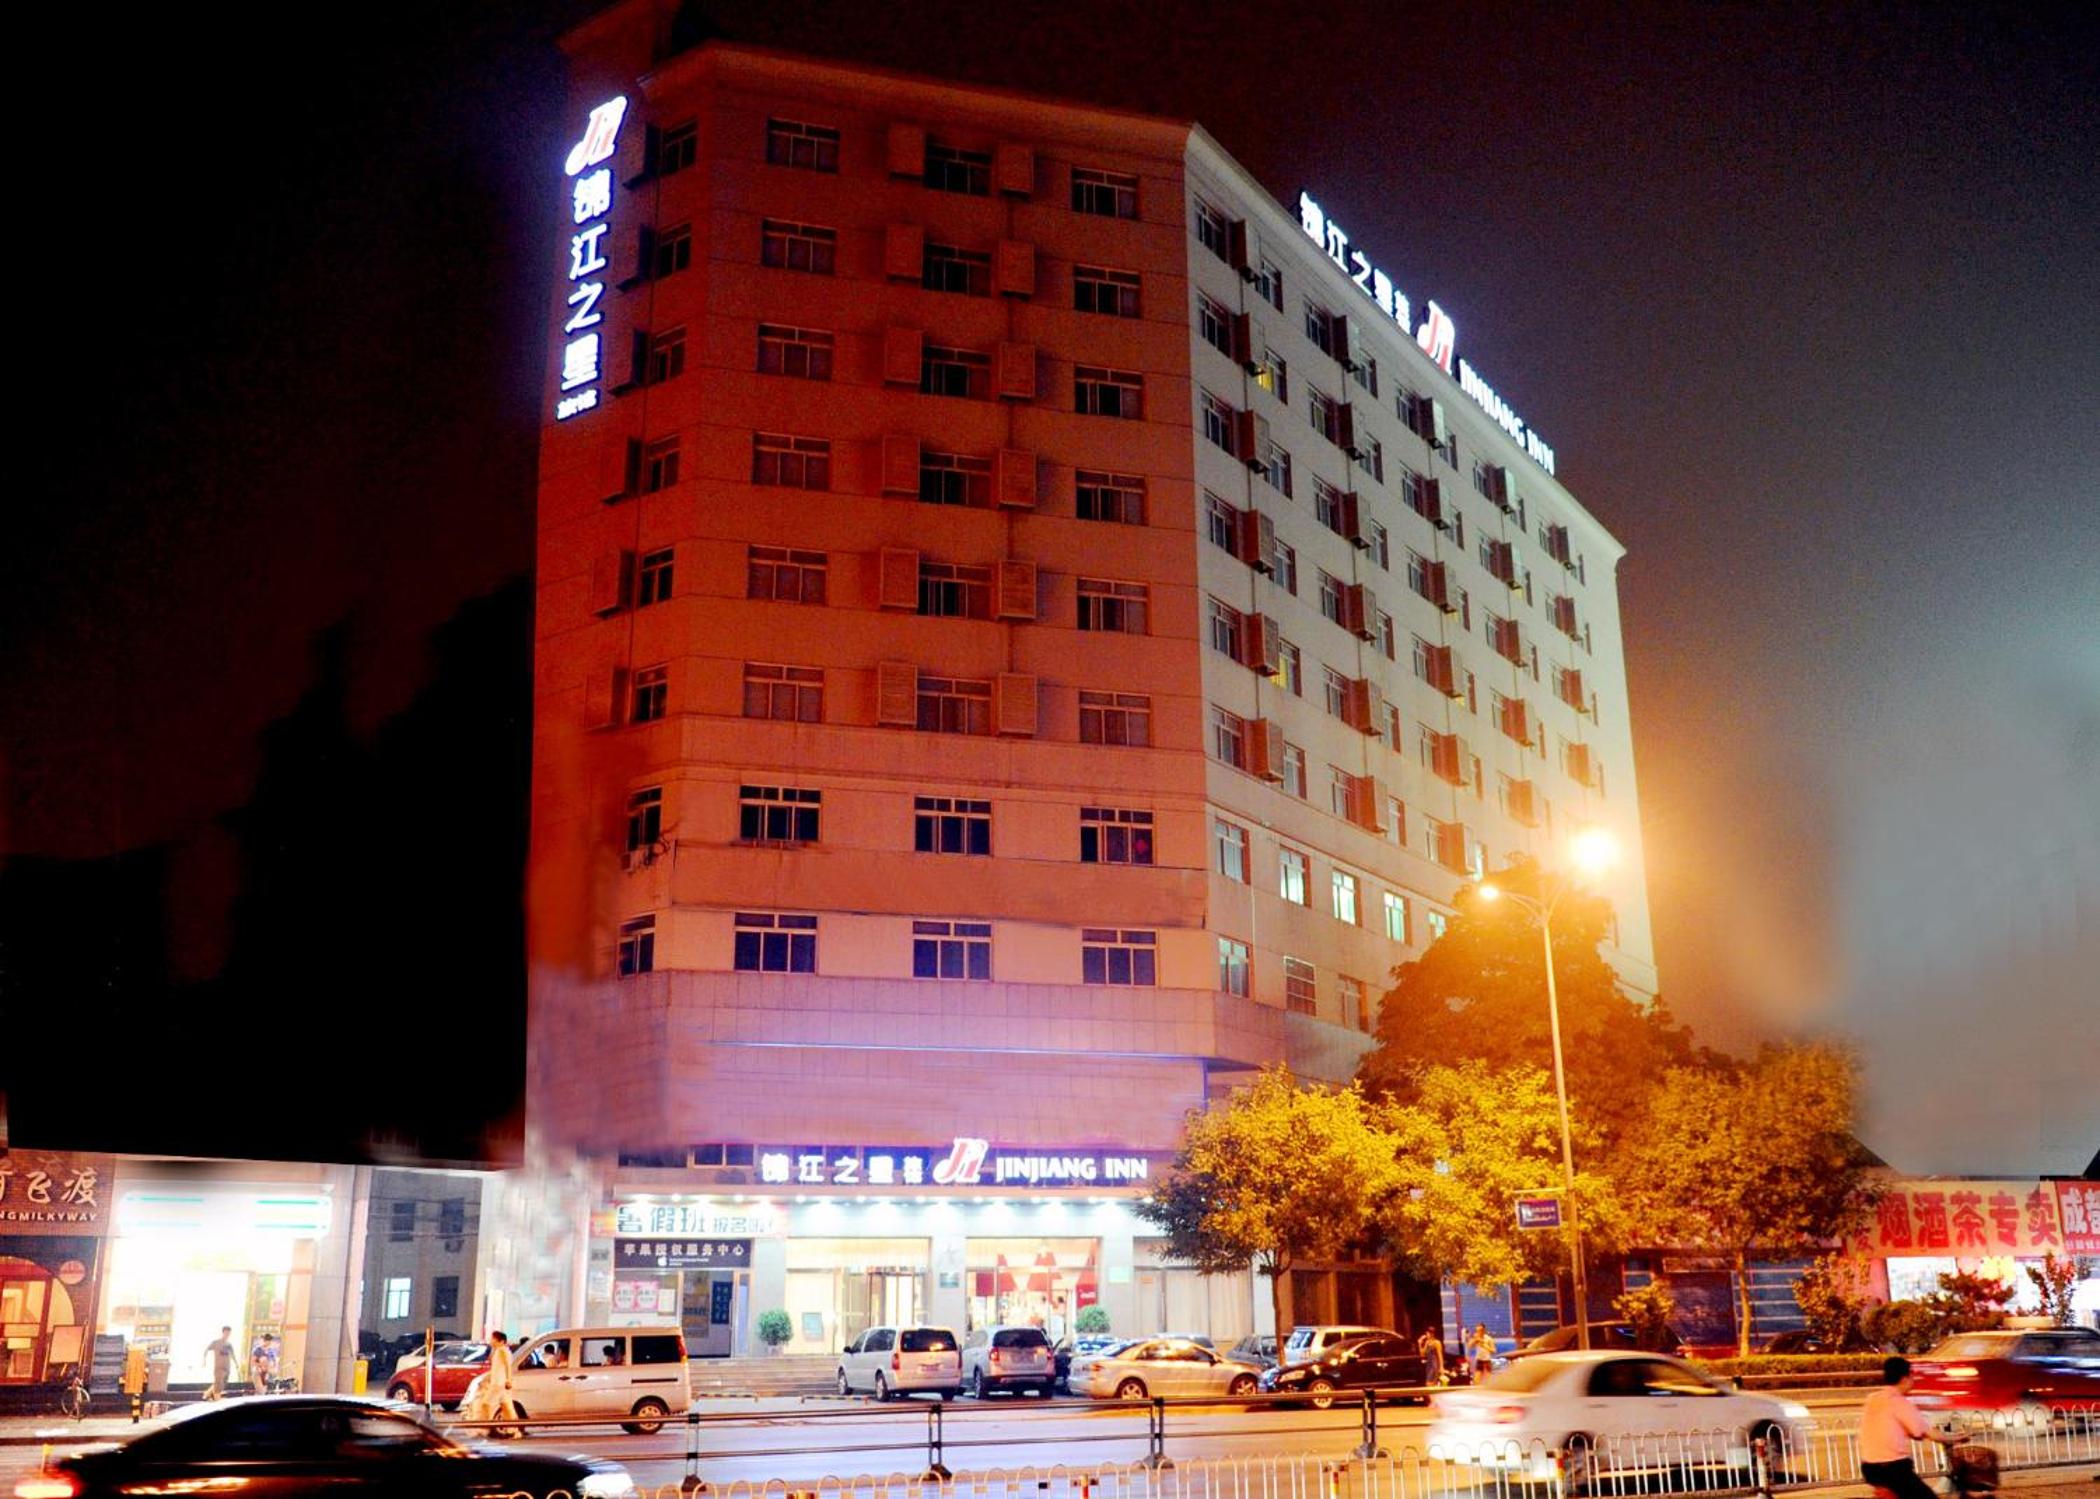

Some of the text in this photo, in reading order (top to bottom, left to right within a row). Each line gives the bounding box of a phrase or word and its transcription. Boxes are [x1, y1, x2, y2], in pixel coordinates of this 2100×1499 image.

[996, 1157, 1147, 1183] JINJIANG INN
[1876, 1190, 2058, 1249] 烟酒茶专卖
